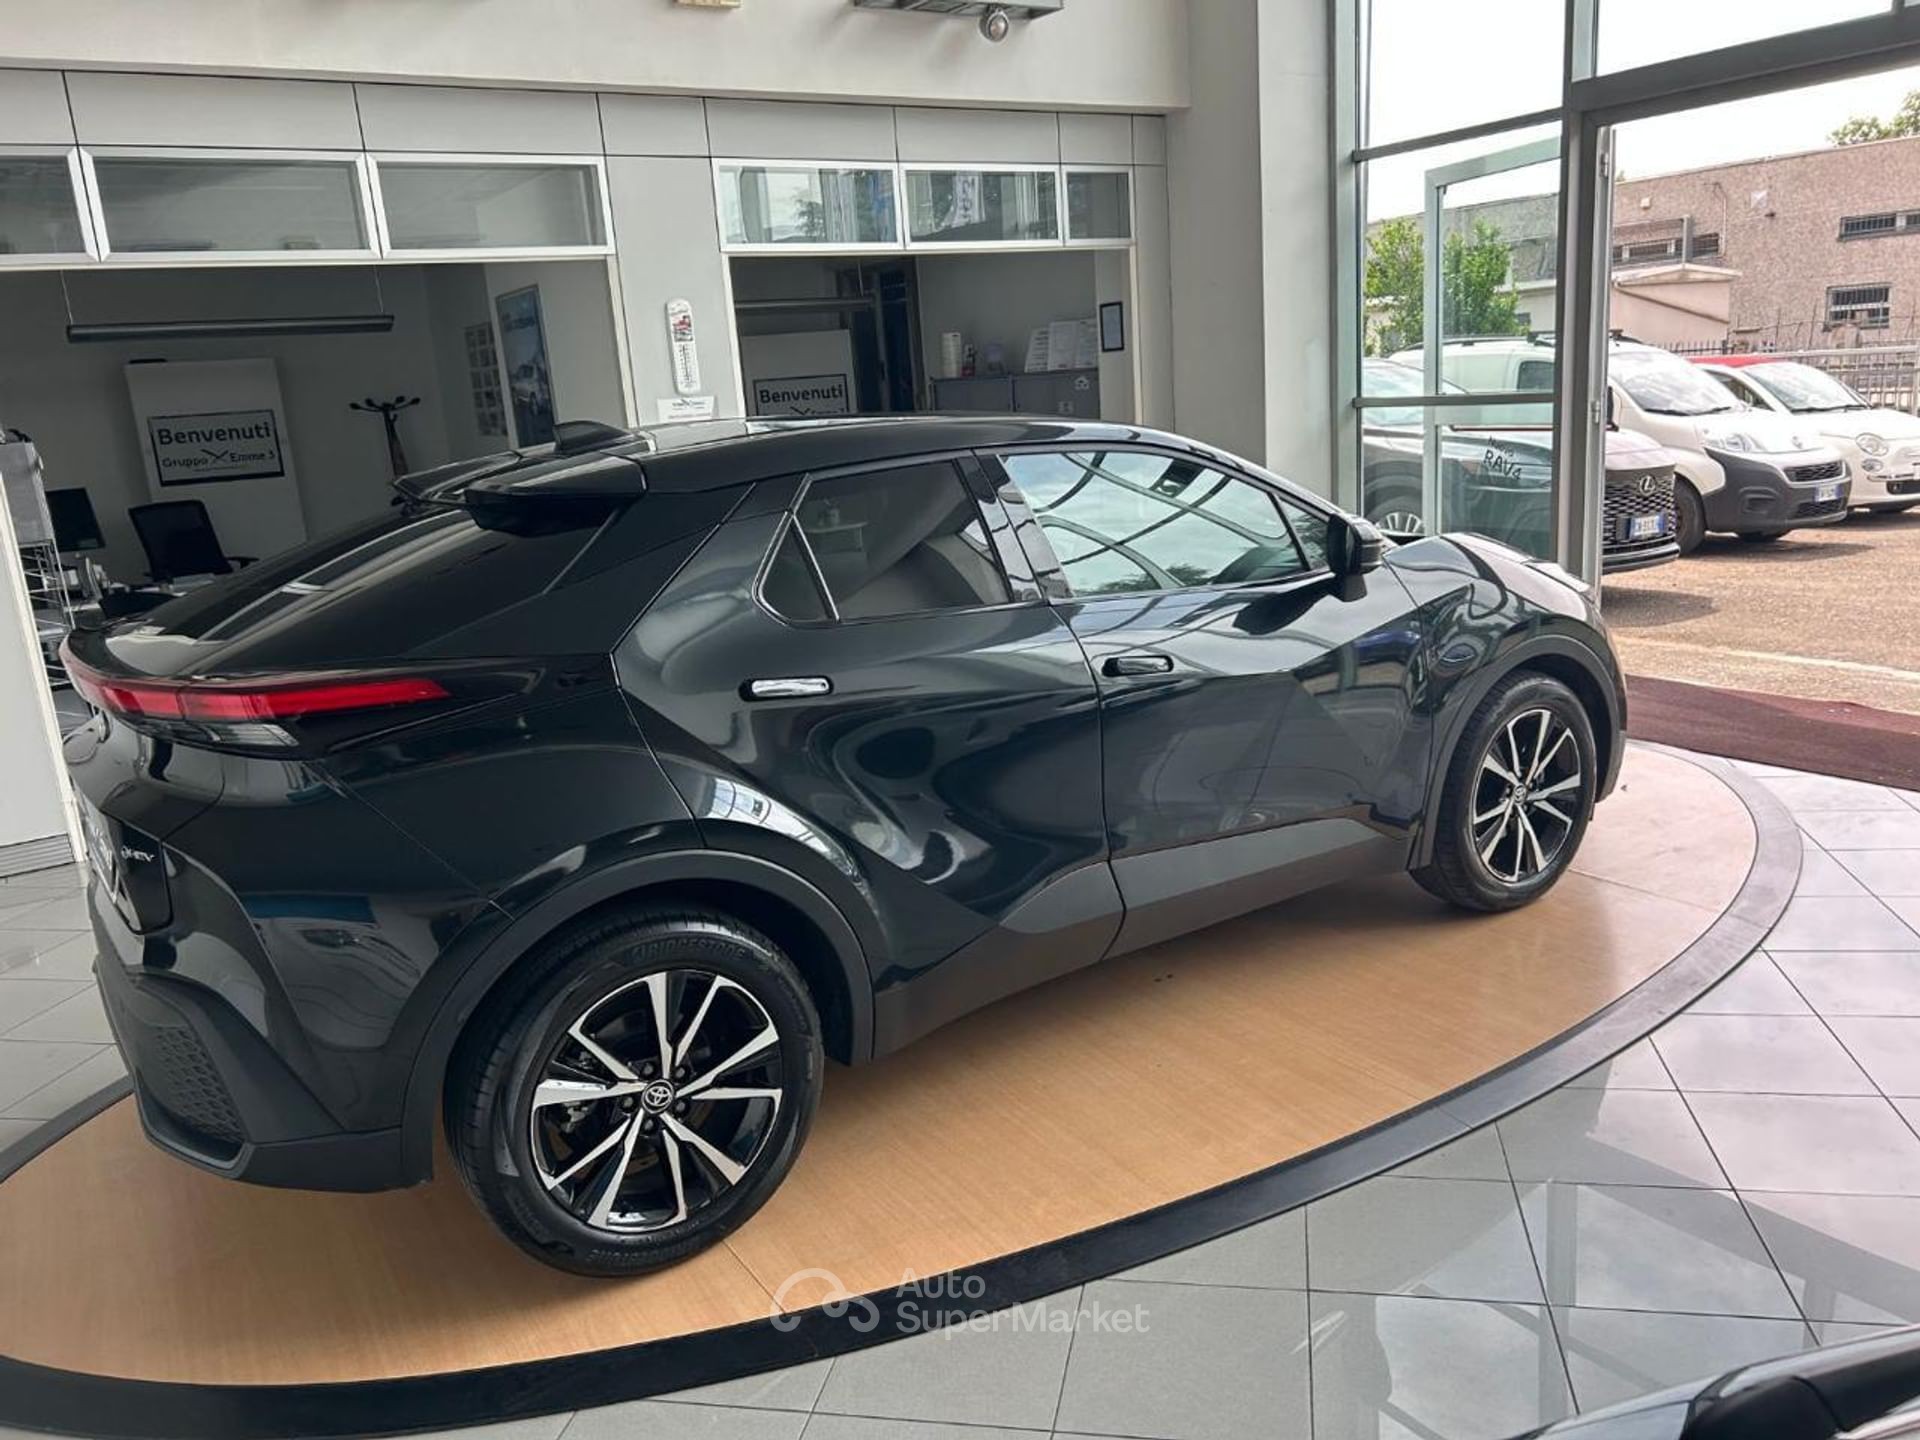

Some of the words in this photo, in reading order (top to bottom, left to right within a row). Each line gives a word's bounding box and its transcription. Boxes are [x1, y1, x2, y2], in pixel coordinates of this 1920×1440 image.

[759, 383, 843, 404] Benvenuti
[157, 421, 271, 445] Benvenuti
[161, 457, 208, 468] Gruppo
[229, 452, 265, 462] Emme
[1483, 449, 1522, 480] RAV4
